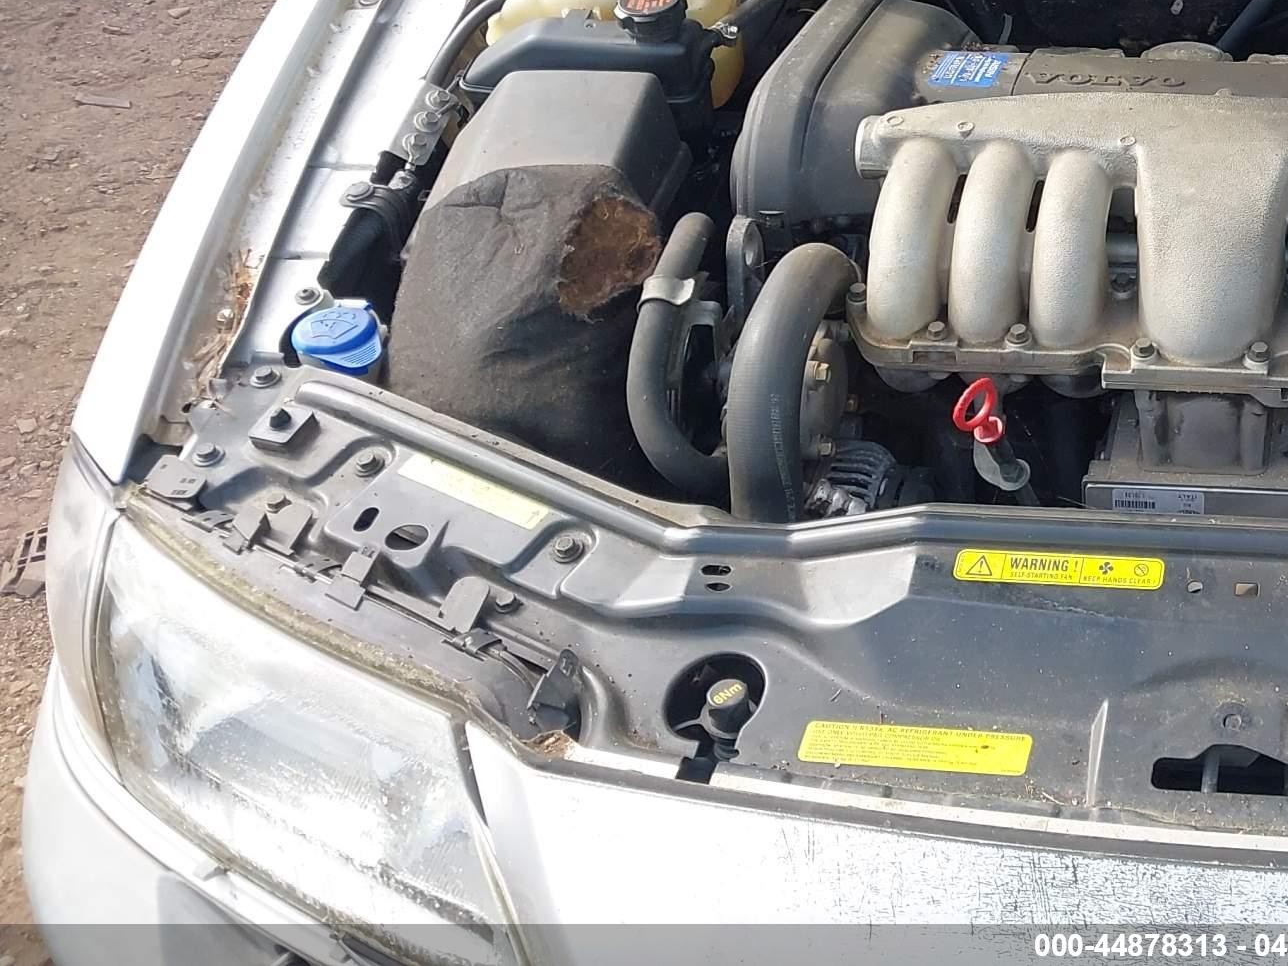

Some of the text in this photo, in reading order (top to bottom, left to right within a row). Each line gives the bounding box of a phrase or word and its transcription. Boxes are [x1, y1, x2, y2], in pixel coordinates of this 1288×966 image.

[1025, 72, 1186, 87] VOLVO
[1010, 556, 1069, 572] WARNING
[1010, 571, 1058, 580] SELF-STARTING
[1102, 576, 1127, 584] HANDS
[815, 722, 849, 730] CAUTION
[900, 727, 952, 737] REFRIGERANT
[955, 731, 983, 739] UNDER
[985, 733, 1026, 742] PRESSURE
